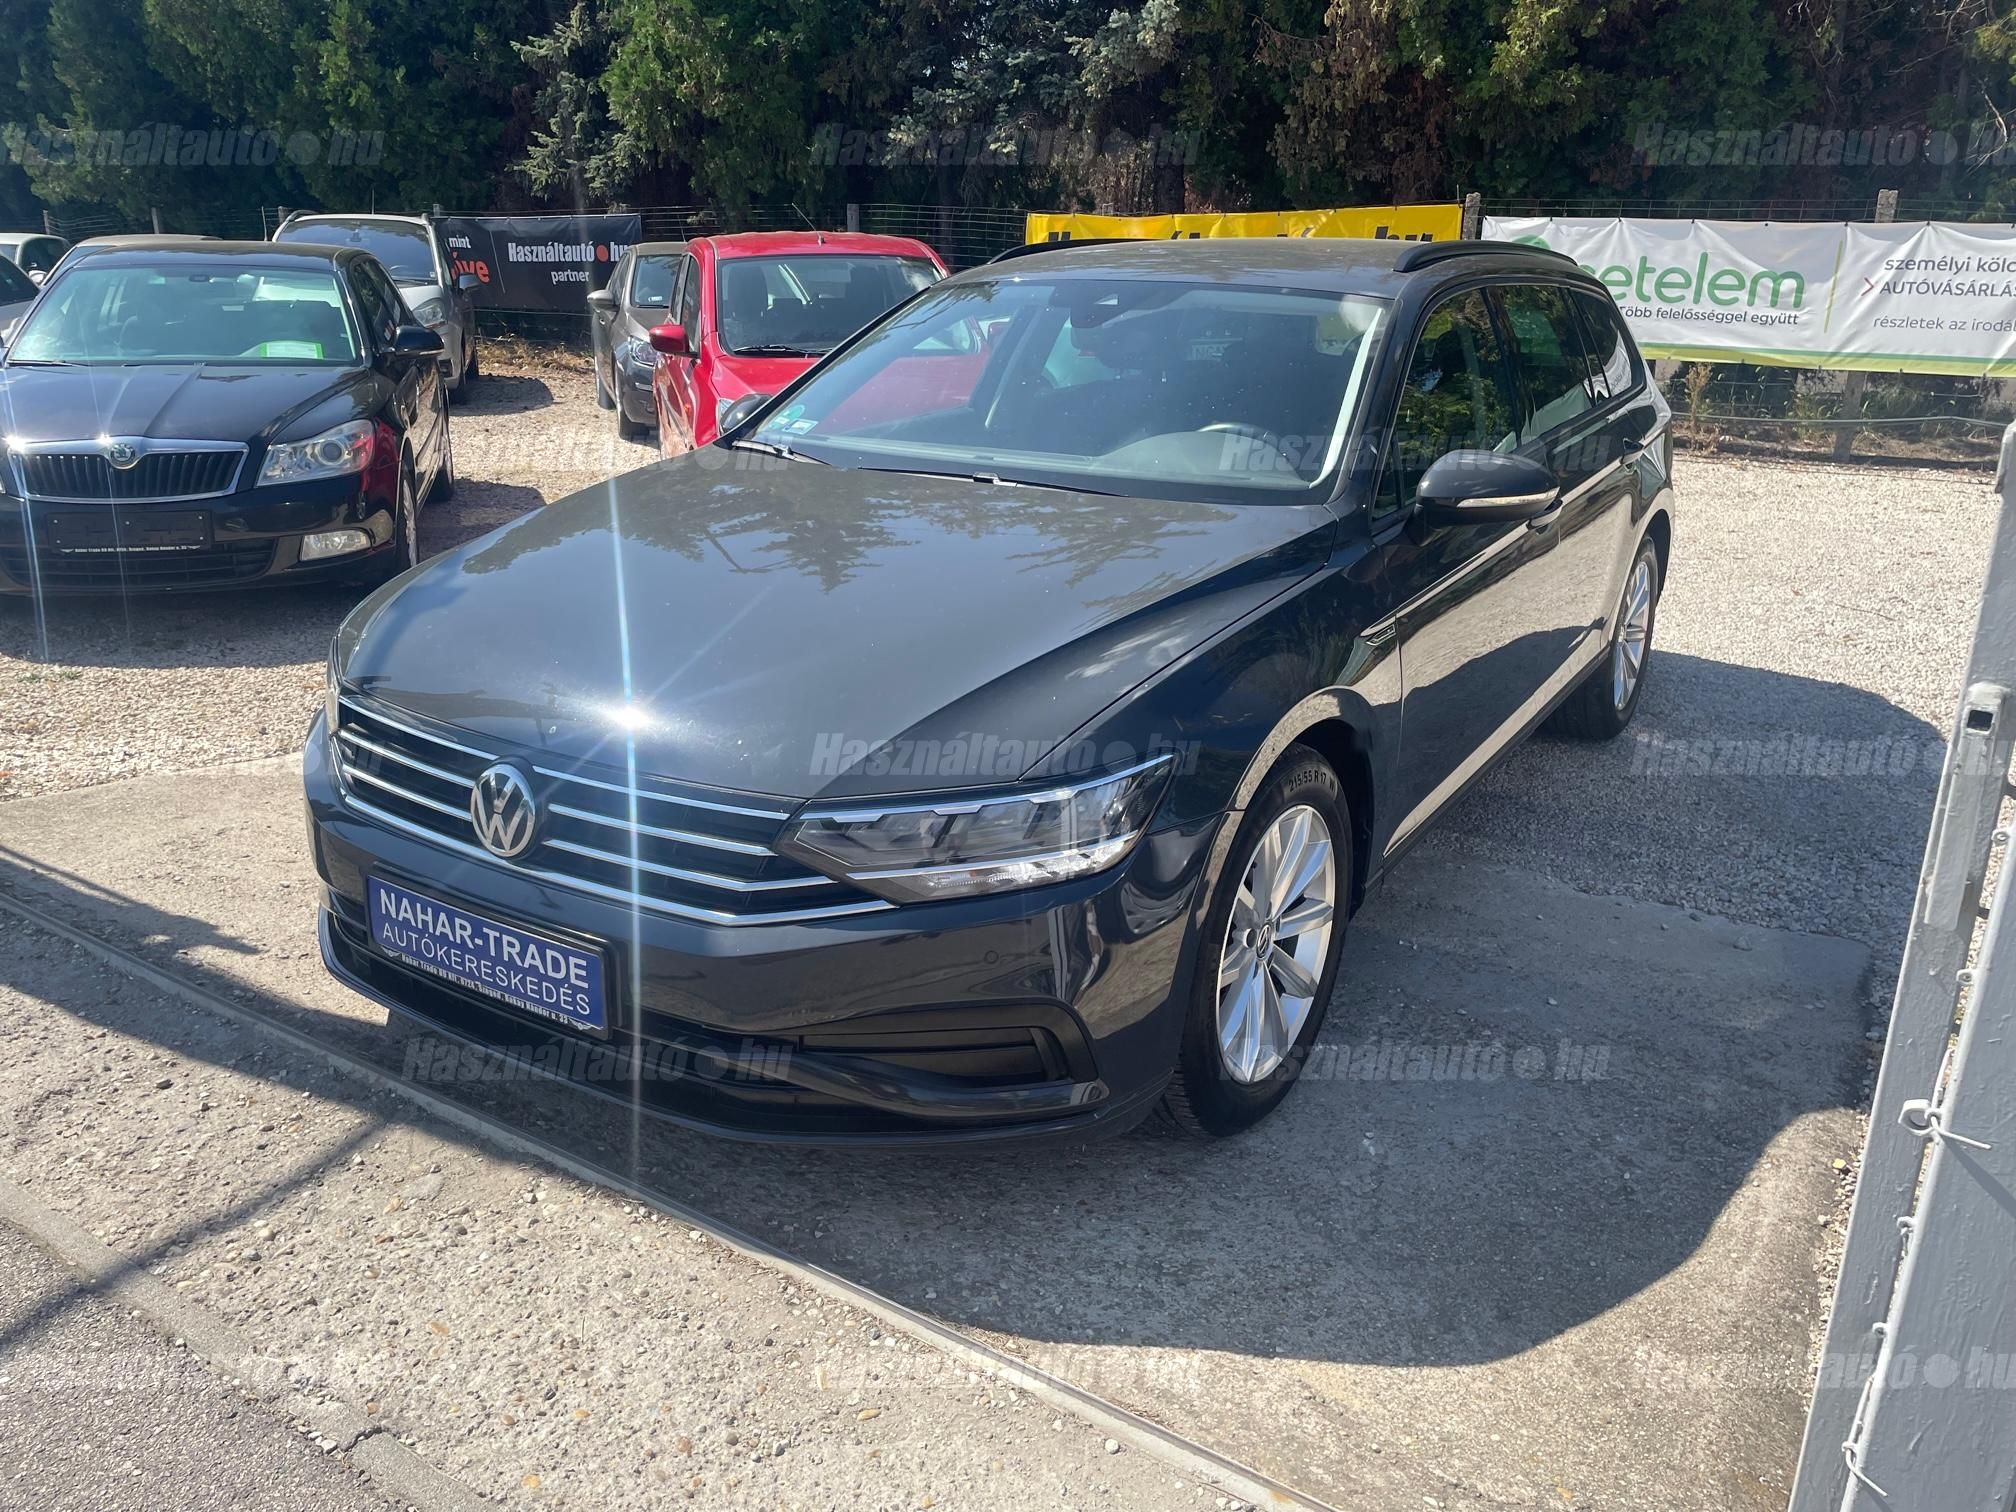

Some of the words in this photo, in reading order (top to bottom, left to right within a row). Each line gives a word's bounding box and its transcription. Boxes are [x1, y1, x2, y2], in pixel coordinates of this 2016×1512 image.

[449, 235, 471, 249] mint
[1884, 256, 1971, 275] személyi
[551, 269, 590, 284] partner
[1656, 307, 1747, 323] felelősséggel
[1751, 312, 1799, 325] együtt
[1873, 316, 1944, 330] részletek
[1948, 320, 1967, 331] az
[380, 888, 589, 989] NAHAR-TRADE
[383, 923, 591, 1015] AUTÓKERESKEDÉS
